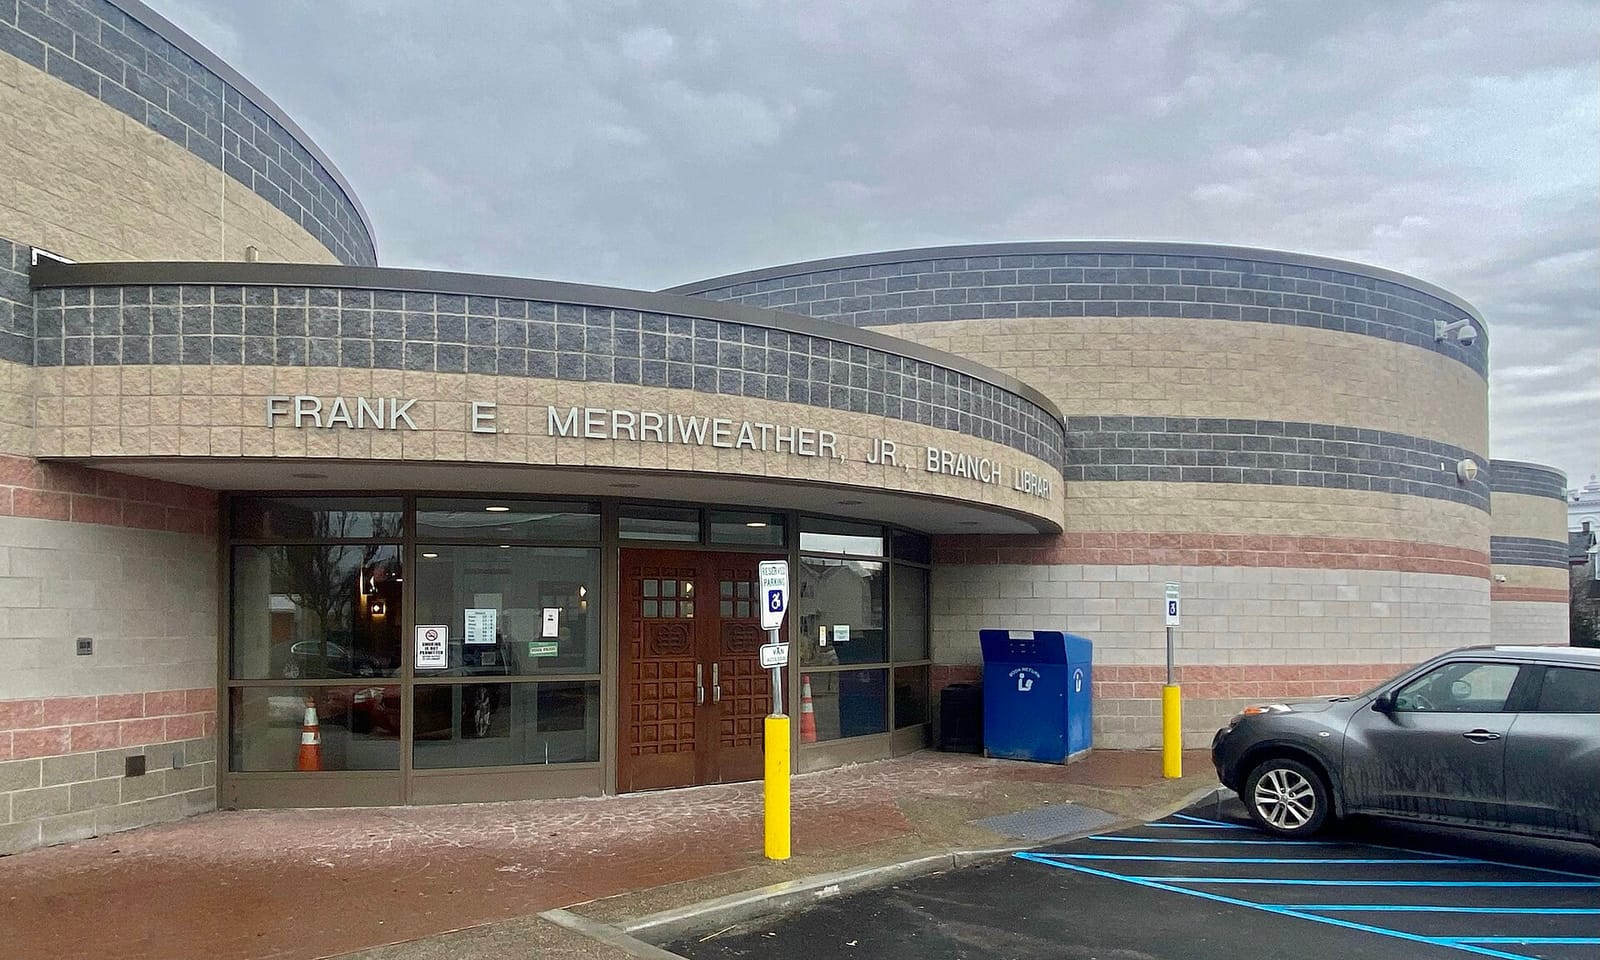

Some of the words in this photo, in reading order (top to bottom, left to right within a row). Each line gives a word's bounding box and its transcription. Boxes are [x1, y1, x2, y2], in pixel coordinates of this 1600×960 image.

[266, 395, 418, 430] FRANK
[472, 401, 510, 434] E.
[546, 405, 847, 464] MERRIWEATHER,
[926, 446, 1002, 485] BRANCH
[1015, 467, 1053, 500] LIBRAR
[762, 566, 785, 575] RESERVED
[764, 577, 785, 586] PARKING
[773, 647, 785, 655] VAN
